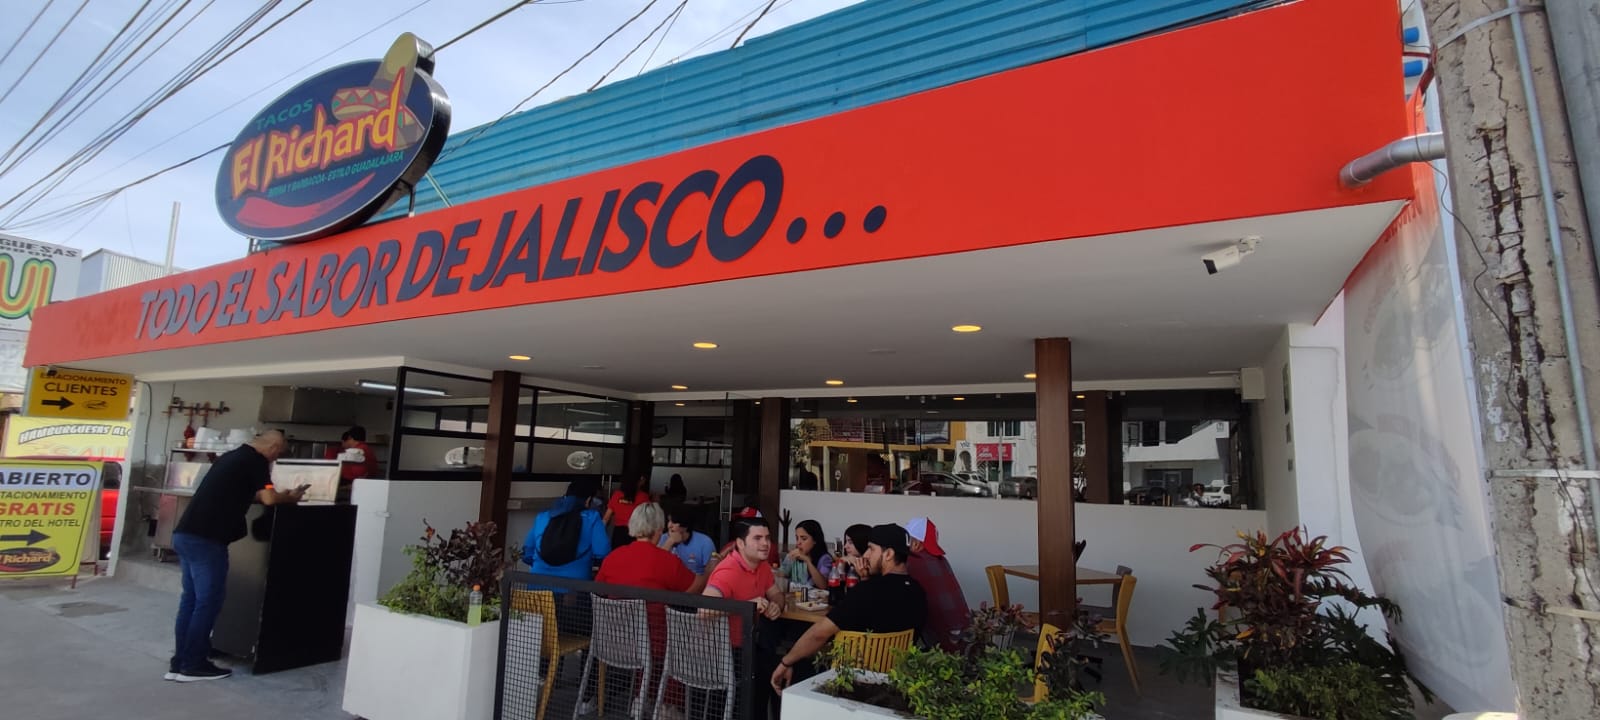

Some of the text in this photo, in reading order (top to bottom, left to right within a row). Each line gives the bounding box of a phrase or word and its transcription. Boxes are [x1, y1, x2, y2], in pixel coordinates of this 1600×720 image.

[255, 99, 313, 131] TACOS
[232, 67, 405, 200] El Richard
[351, 151, 404, 175] GUADALAJARA
[135, 280, 220, 340] TODO
[215, 267, 258, 328] EL
[256, 239, 400, 324] SABOR
[396, 218, 482, 303] DE
[44, 382, 118, 396] CLIENTES
[18, 424, 112, 445] HAMBURGUESAS
[112, 426, 126, 436] AL
[23, 520, 43, 528] DEL
[48, 519, 81, 528] HOTEL
[3, 551, 52, 564] Richard
